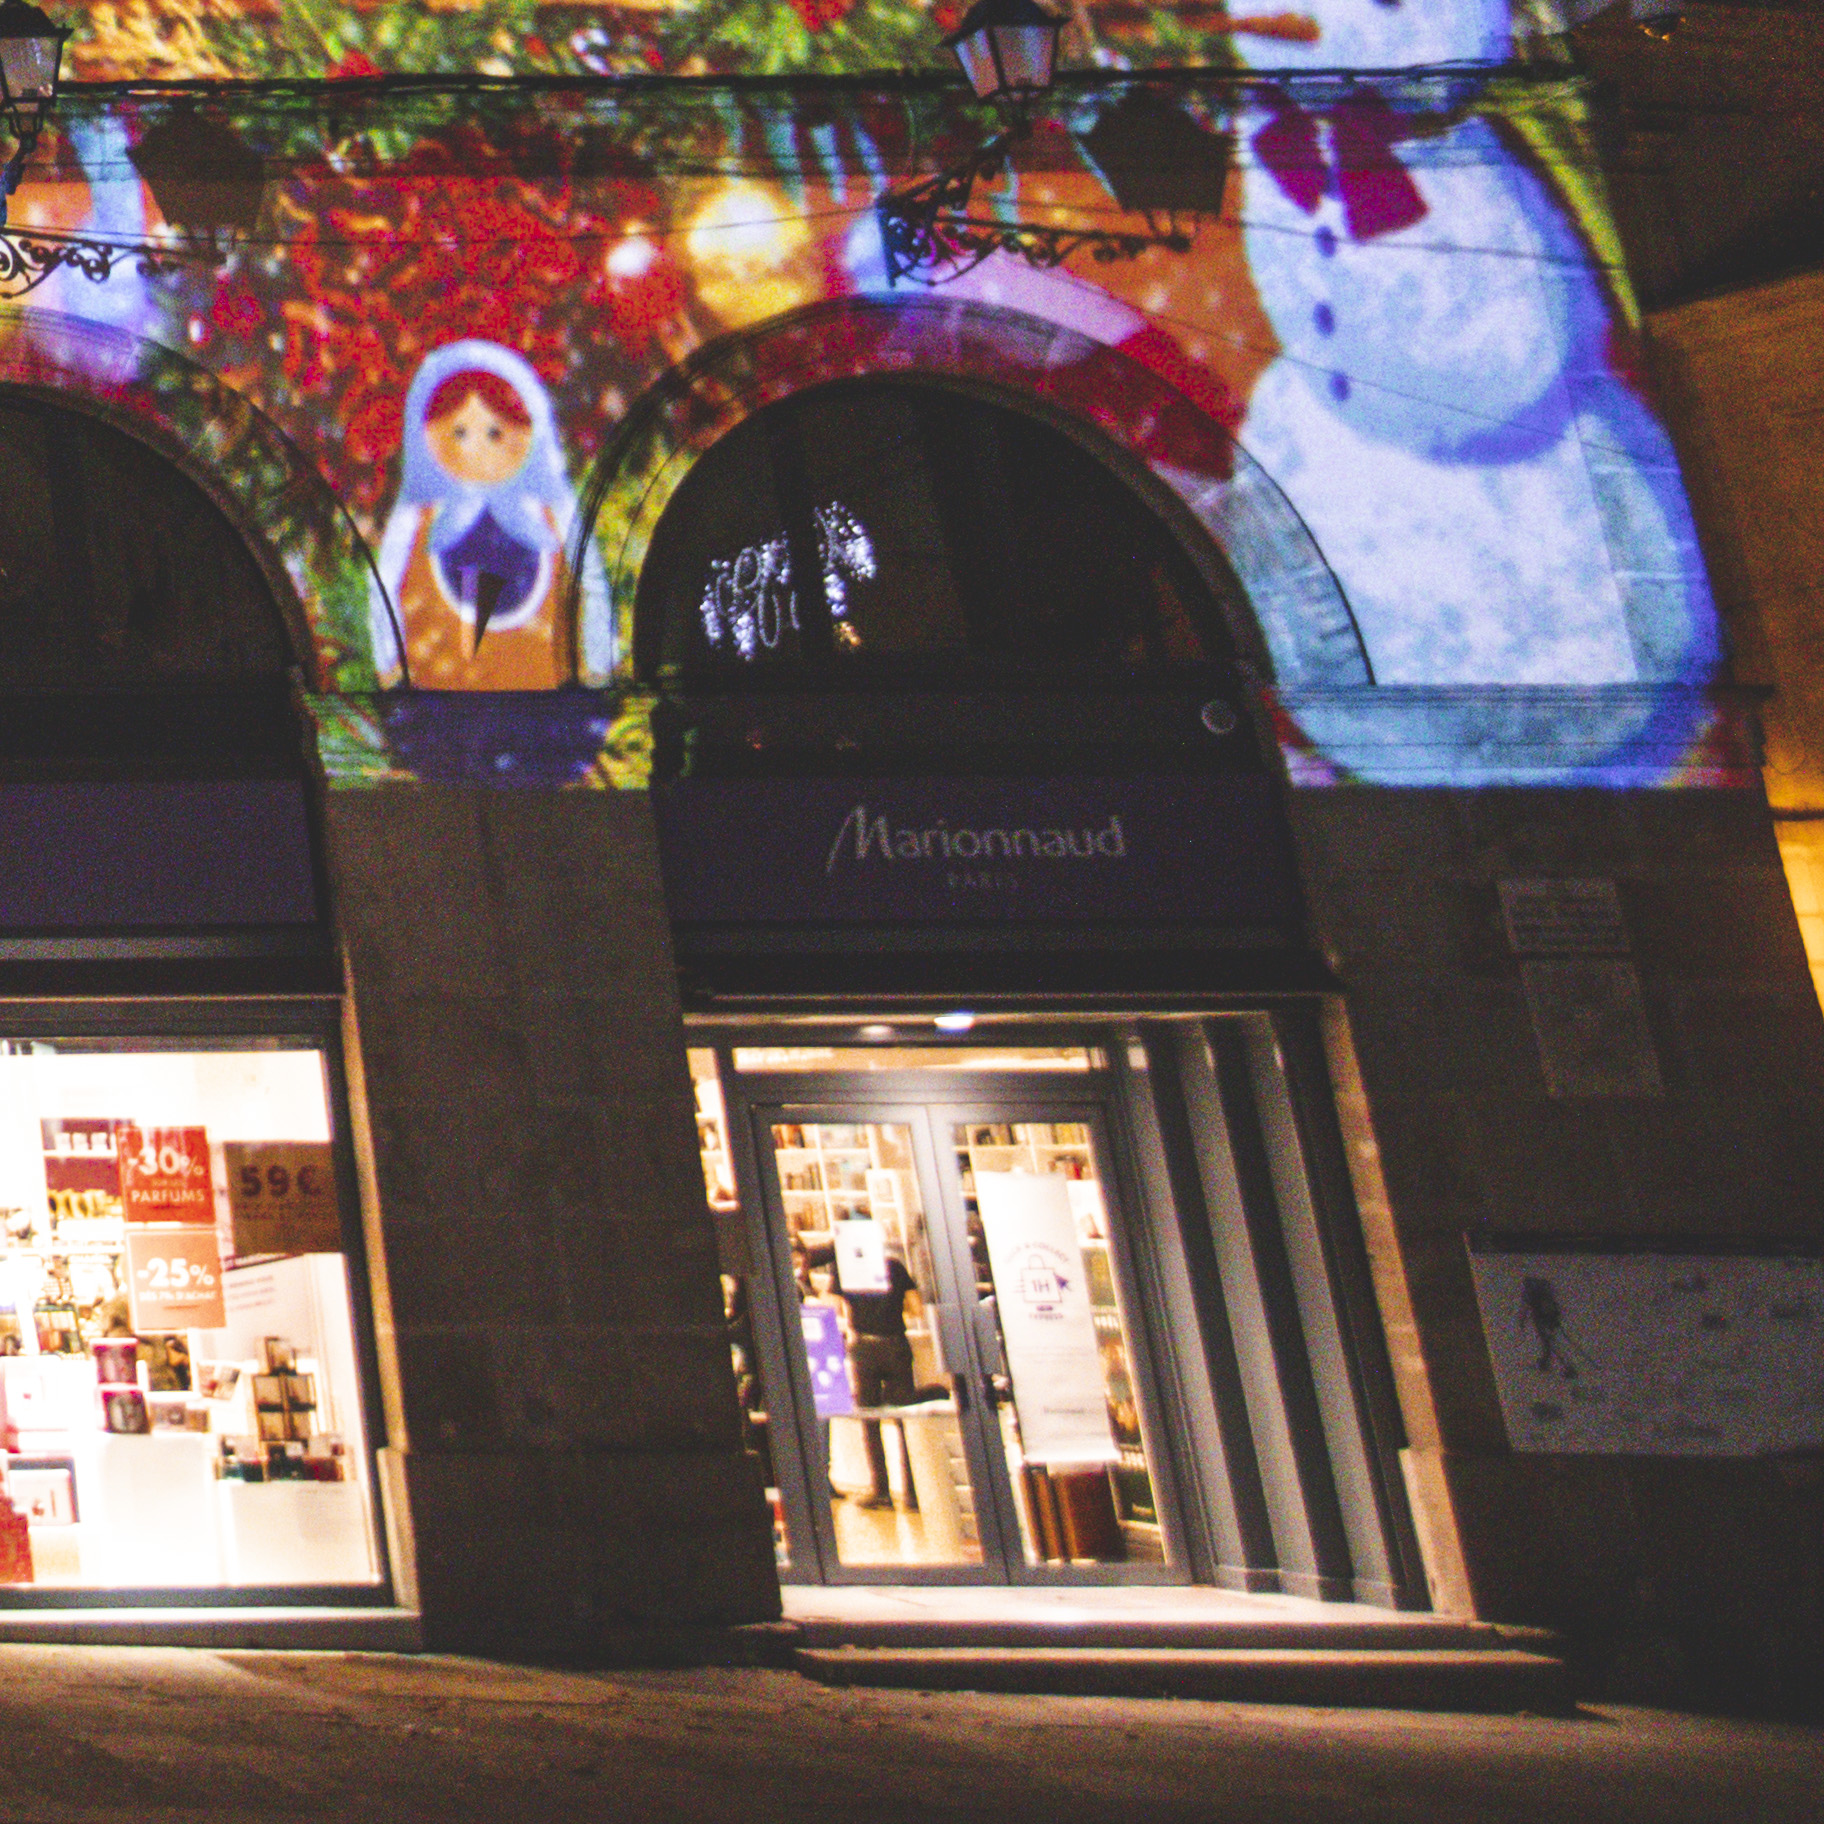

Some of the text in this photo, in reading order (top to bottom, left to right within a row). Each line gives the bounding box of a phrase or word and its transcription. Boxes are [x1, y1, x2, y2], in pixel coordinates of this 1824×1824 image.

[825, 804, 1127, 875] Marionnaud
[127, 1145, 205, 1176] -30%
[130, 1189, 206, 1204] PARFUMS
[136, 1257, 216, 1288] -25%
